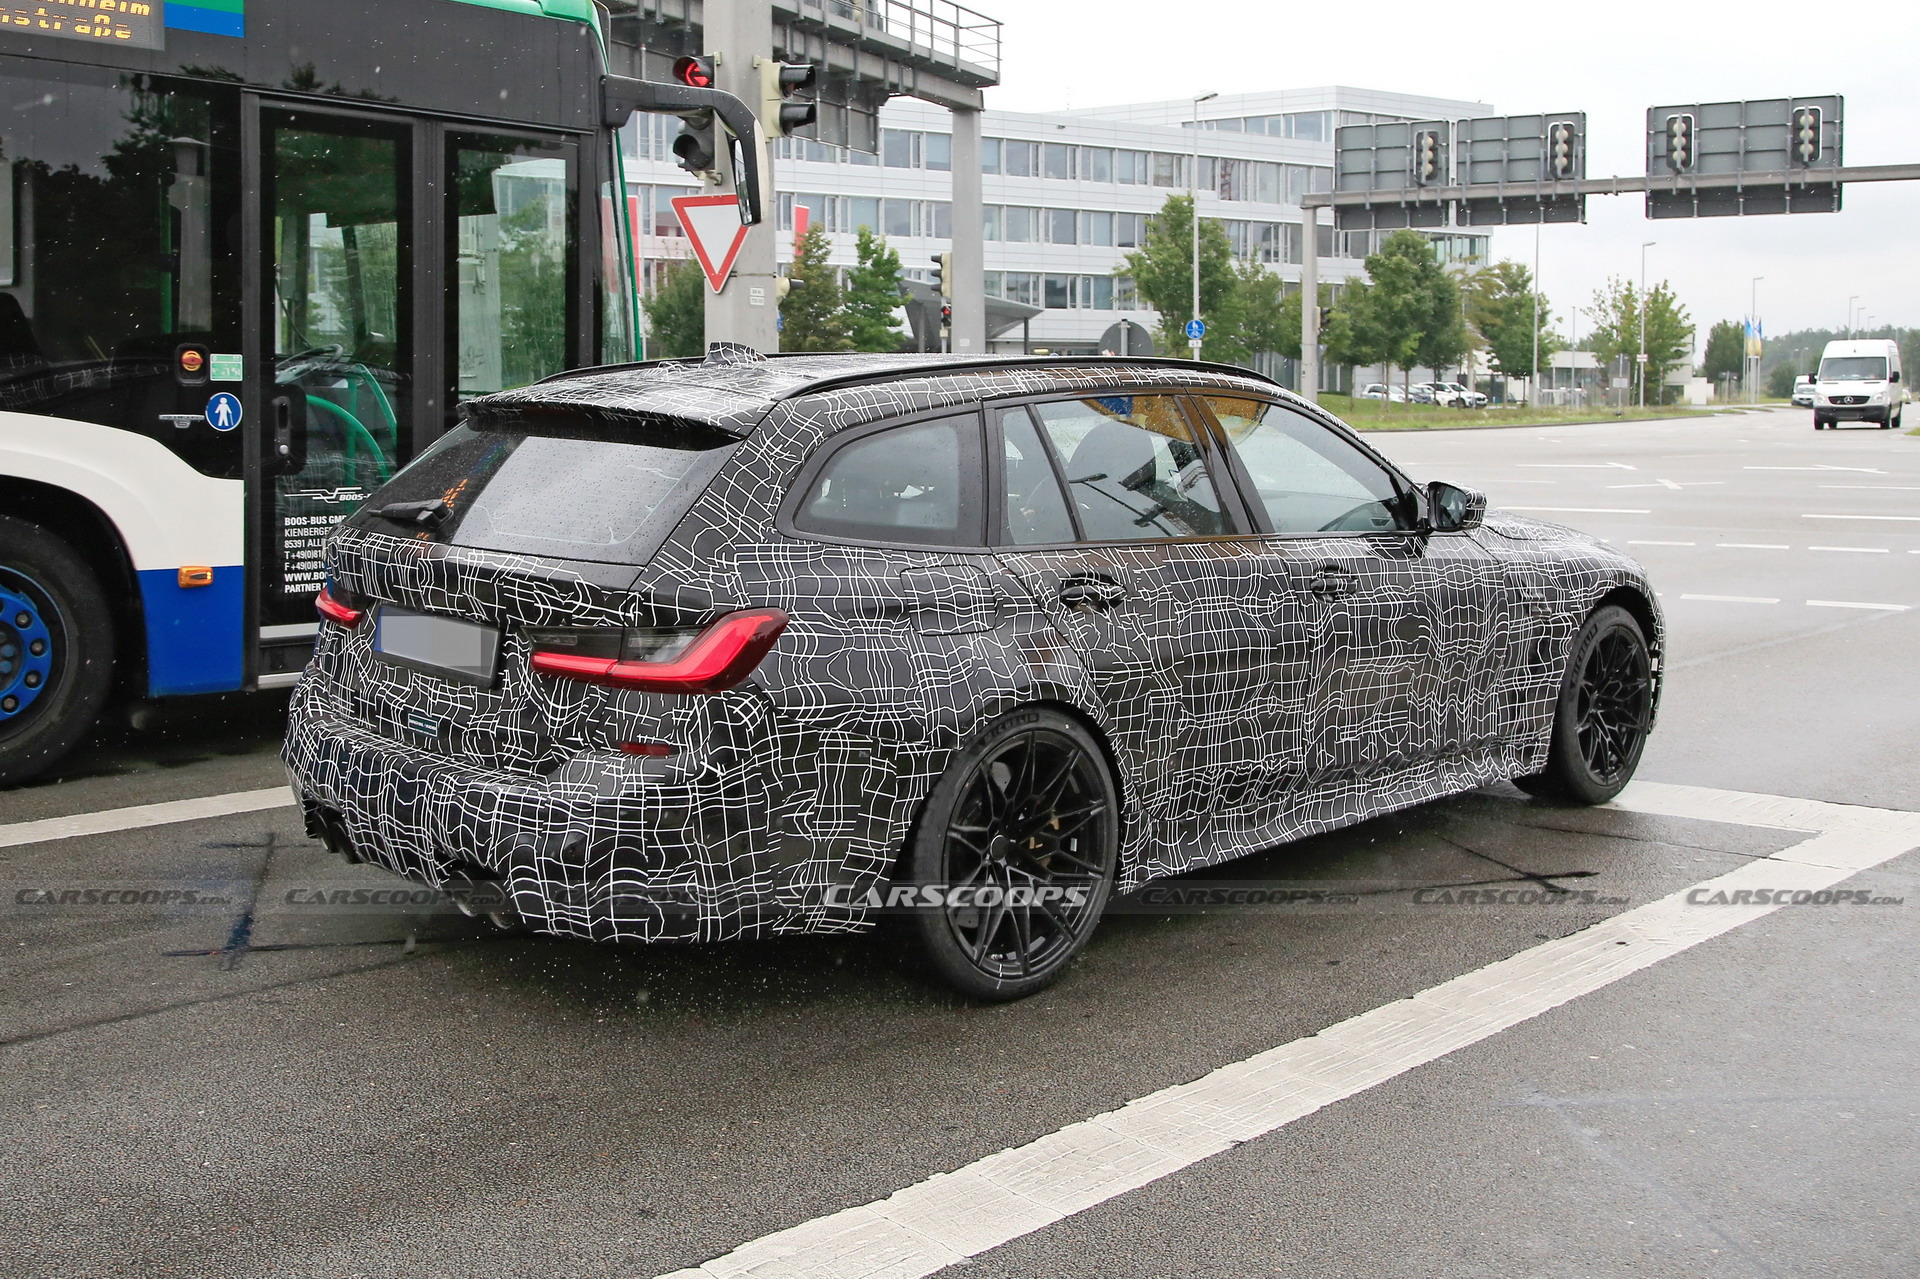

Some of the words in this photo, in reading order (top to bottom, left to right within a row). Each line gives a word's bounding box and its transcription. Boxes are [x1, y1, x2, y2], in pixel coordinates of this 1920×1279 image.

[284, 515, 328, 526] BOOS-BUS
[284, 539, 305, 549] 85391
[307, 539, 322, 548] ALL
[291, 549, 322, 560] +49(0)81
[284, 583, 321, 593] PARTNER
